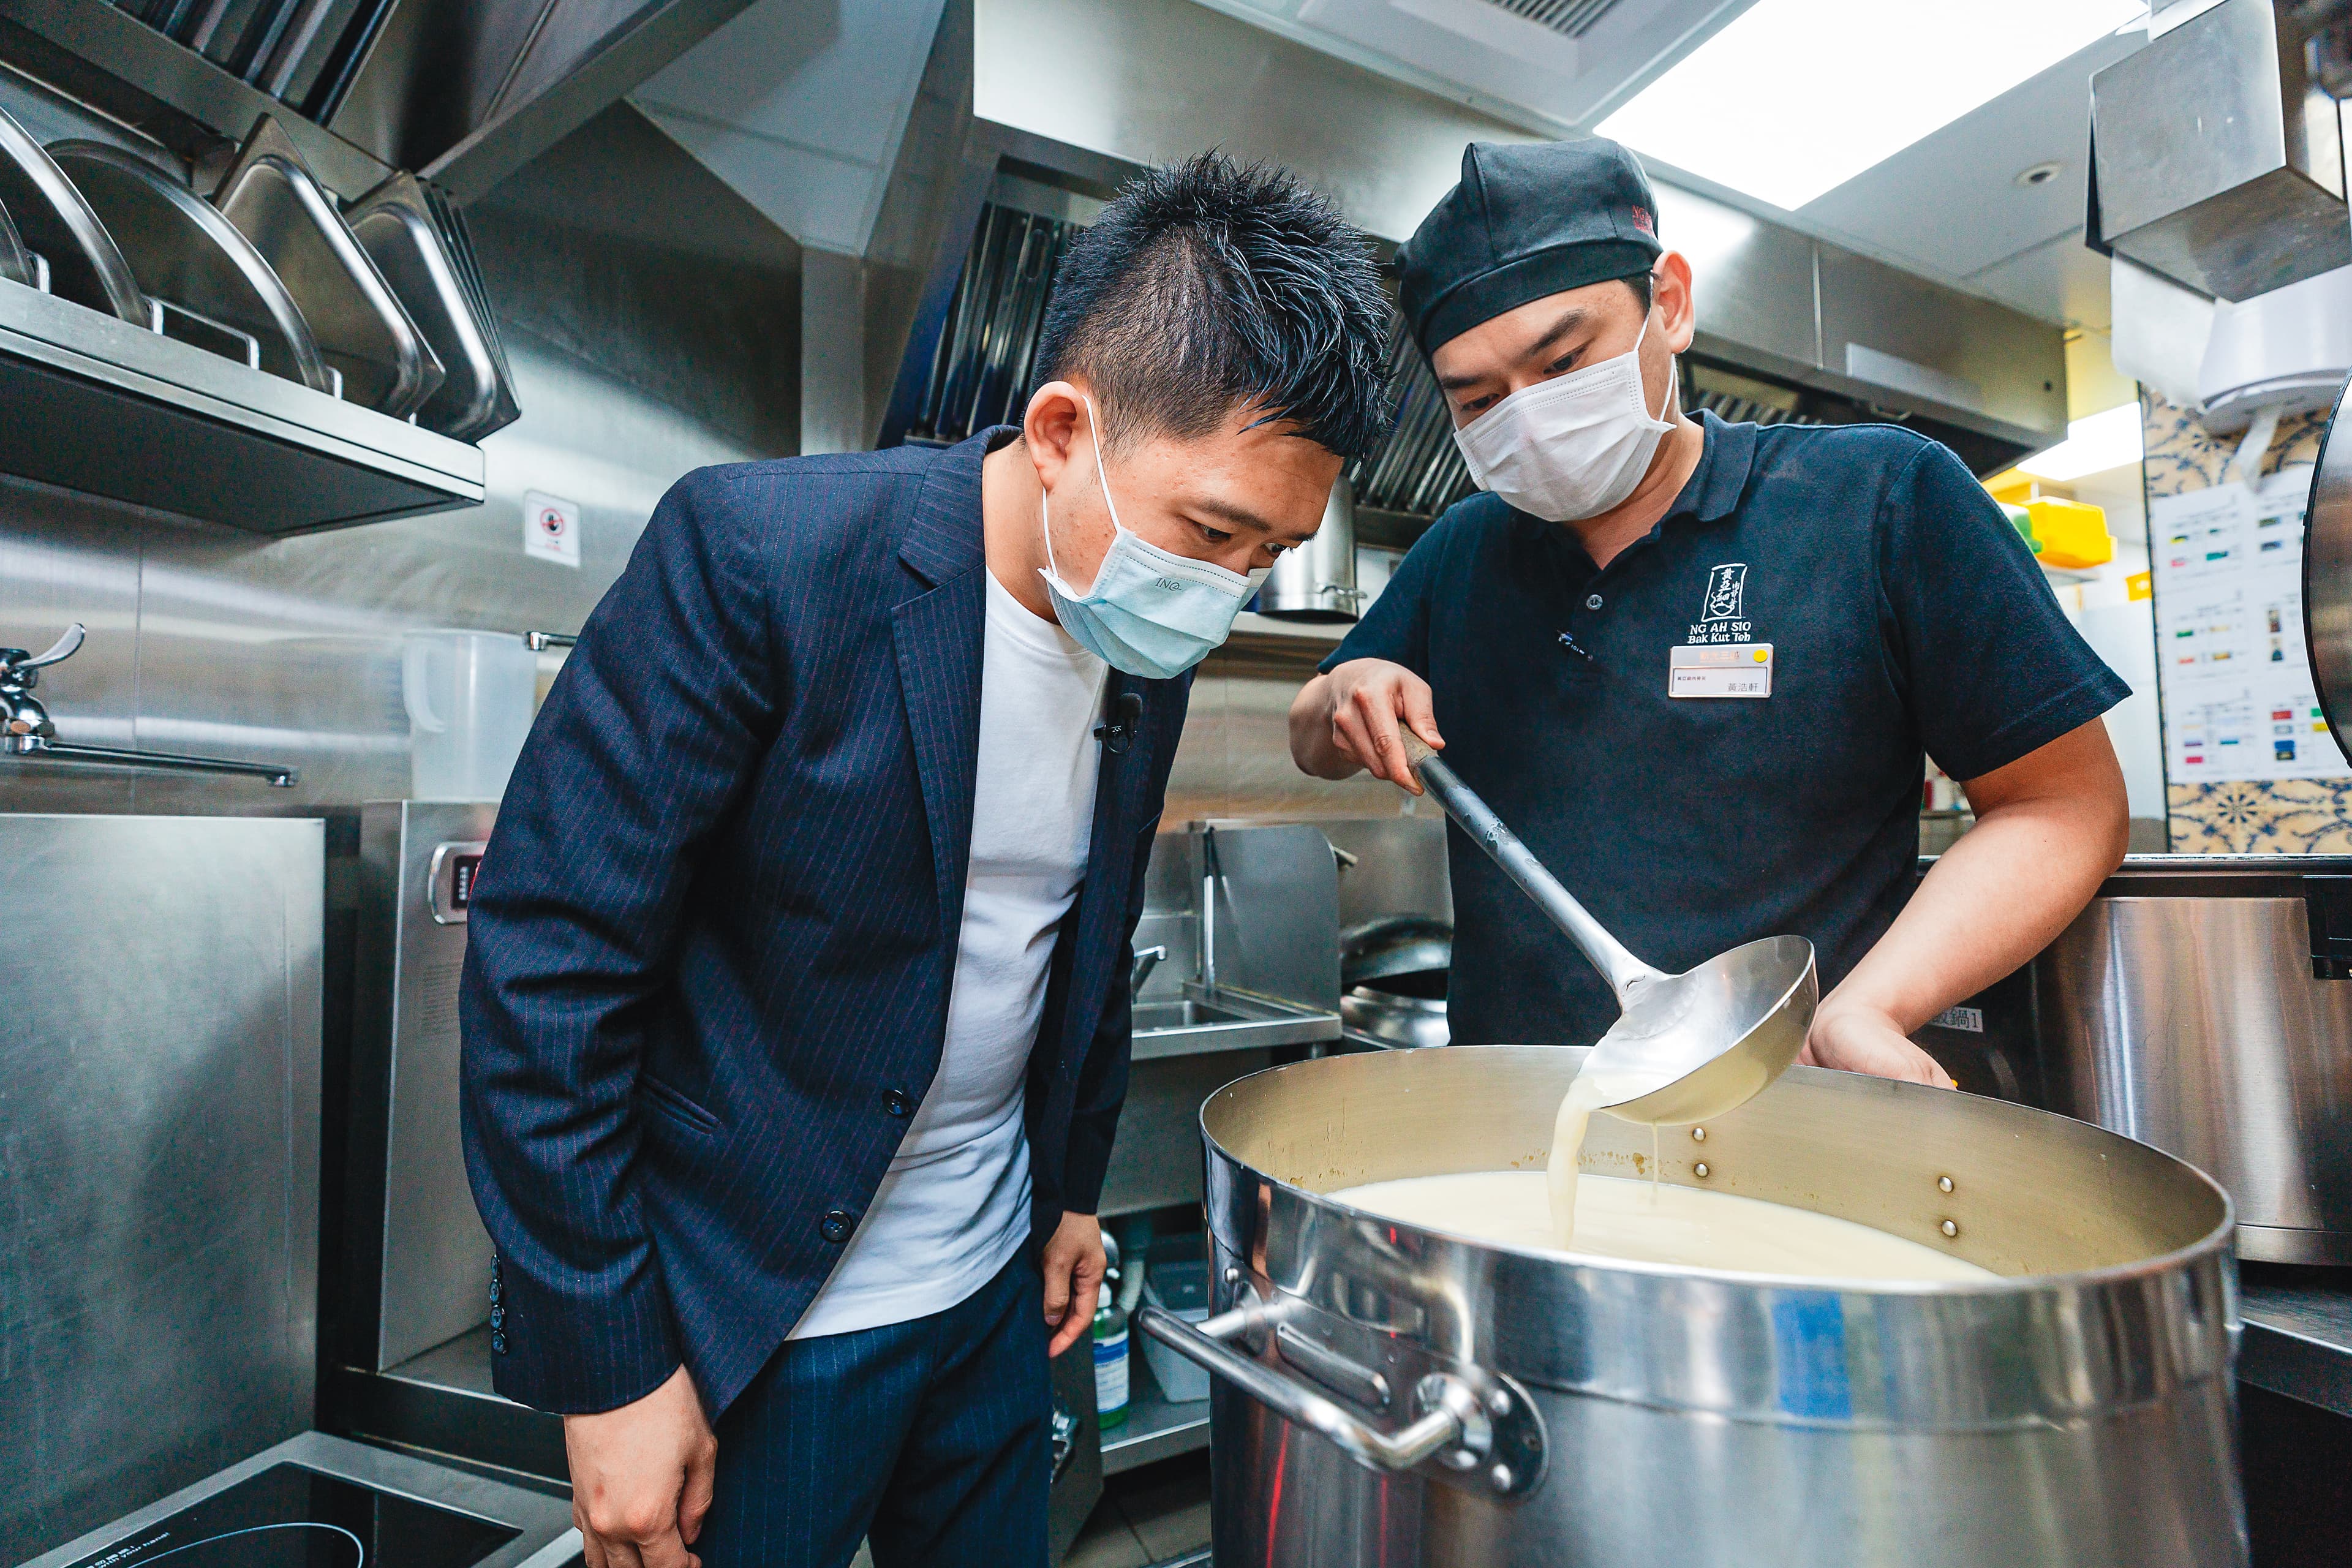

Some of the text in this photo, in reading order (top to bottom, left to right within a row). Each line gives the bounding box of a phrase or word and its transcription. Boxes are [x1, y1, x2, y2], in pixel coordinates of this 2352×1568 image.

[1690, 620, 1752, 635] NG AH SIO
[1687, 631, 1751, 644] Bak Kut Teh
